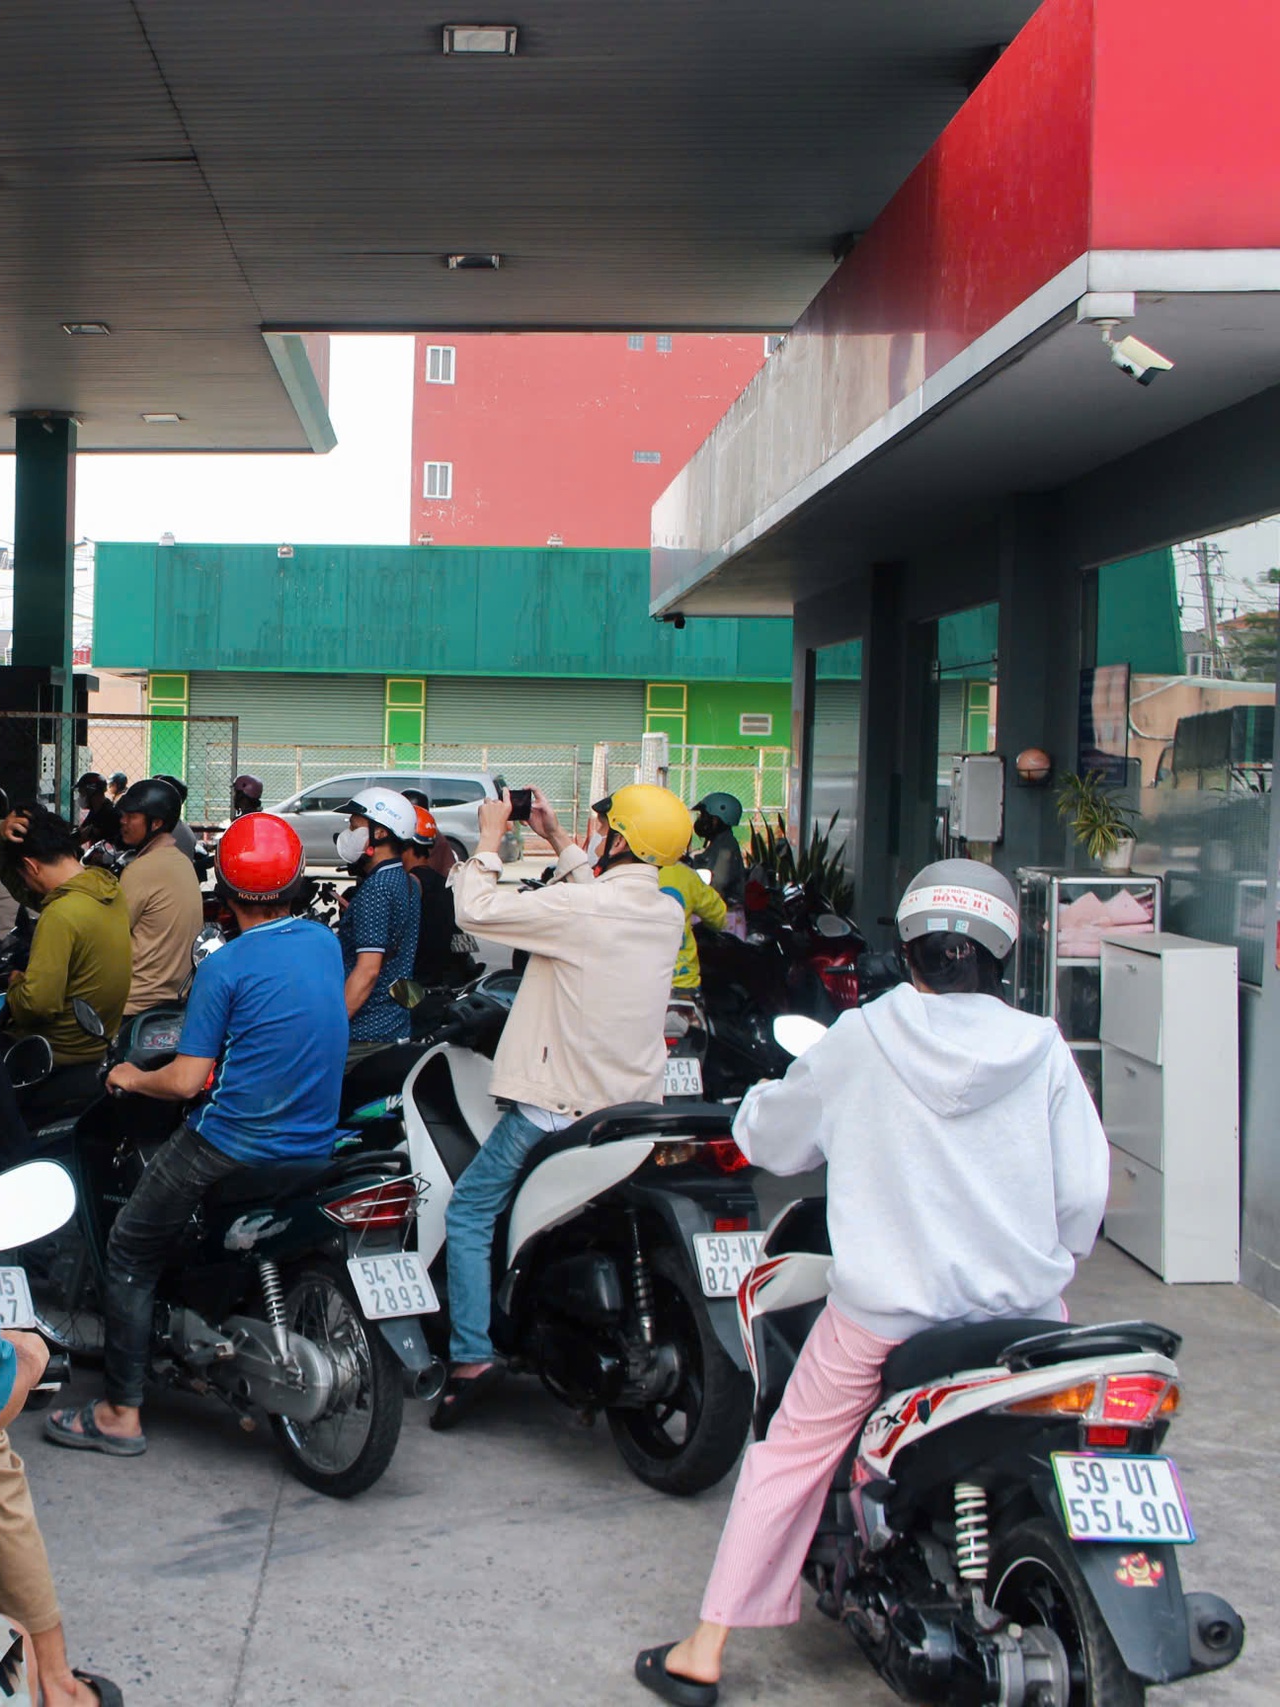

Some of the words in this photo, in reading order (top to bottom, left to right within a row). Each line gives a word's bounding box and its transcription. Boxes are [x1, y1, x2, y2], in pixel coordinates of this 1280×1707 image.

[360, 1258, 417, 1285] 54-Y6
[706, 1266, 741, 1291] 821
[370, 1284, 427, 1313] 2893
[1070, 1461, 1157, 1496] 59-U1
[1069, 1498, 1183, 1535] 554.90
